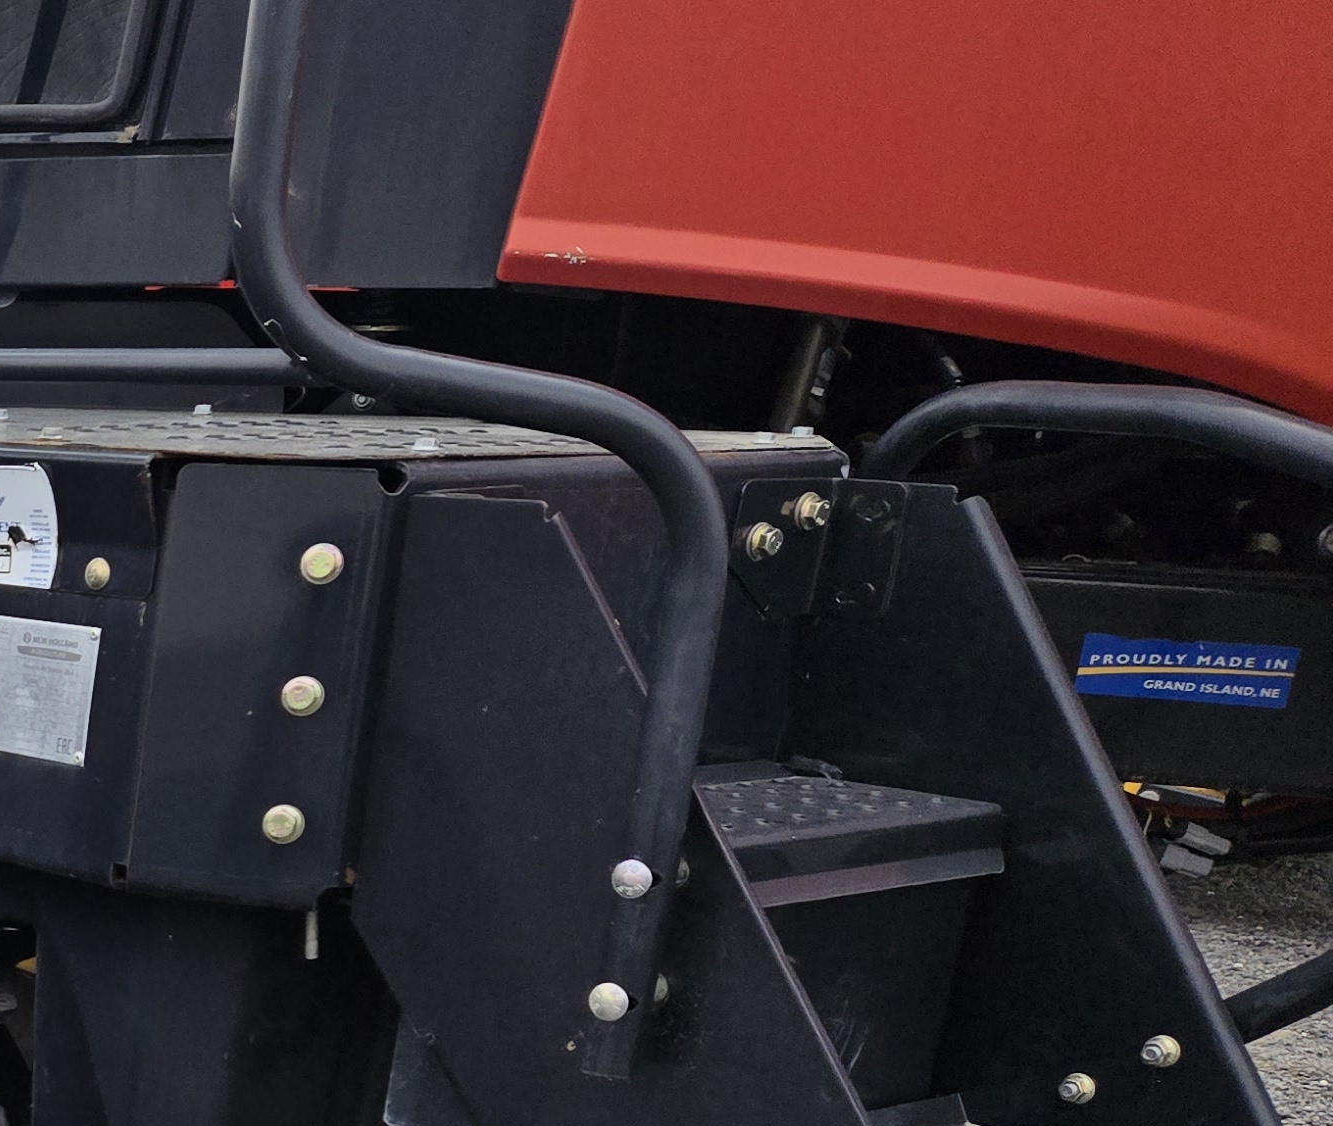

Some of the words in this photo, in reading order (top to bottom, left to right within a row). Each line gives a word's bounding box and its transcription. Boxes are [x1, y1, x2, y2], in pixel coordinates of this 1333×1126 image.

[1089, 653, 1188, 666] PROUDLY
[1196, 655, 1256, 669] MADE
[1265, 658, 1289, 670] IN
[1143, 679, 1196, 693] GRAND
[1260, 687, 1281, 699] NE
